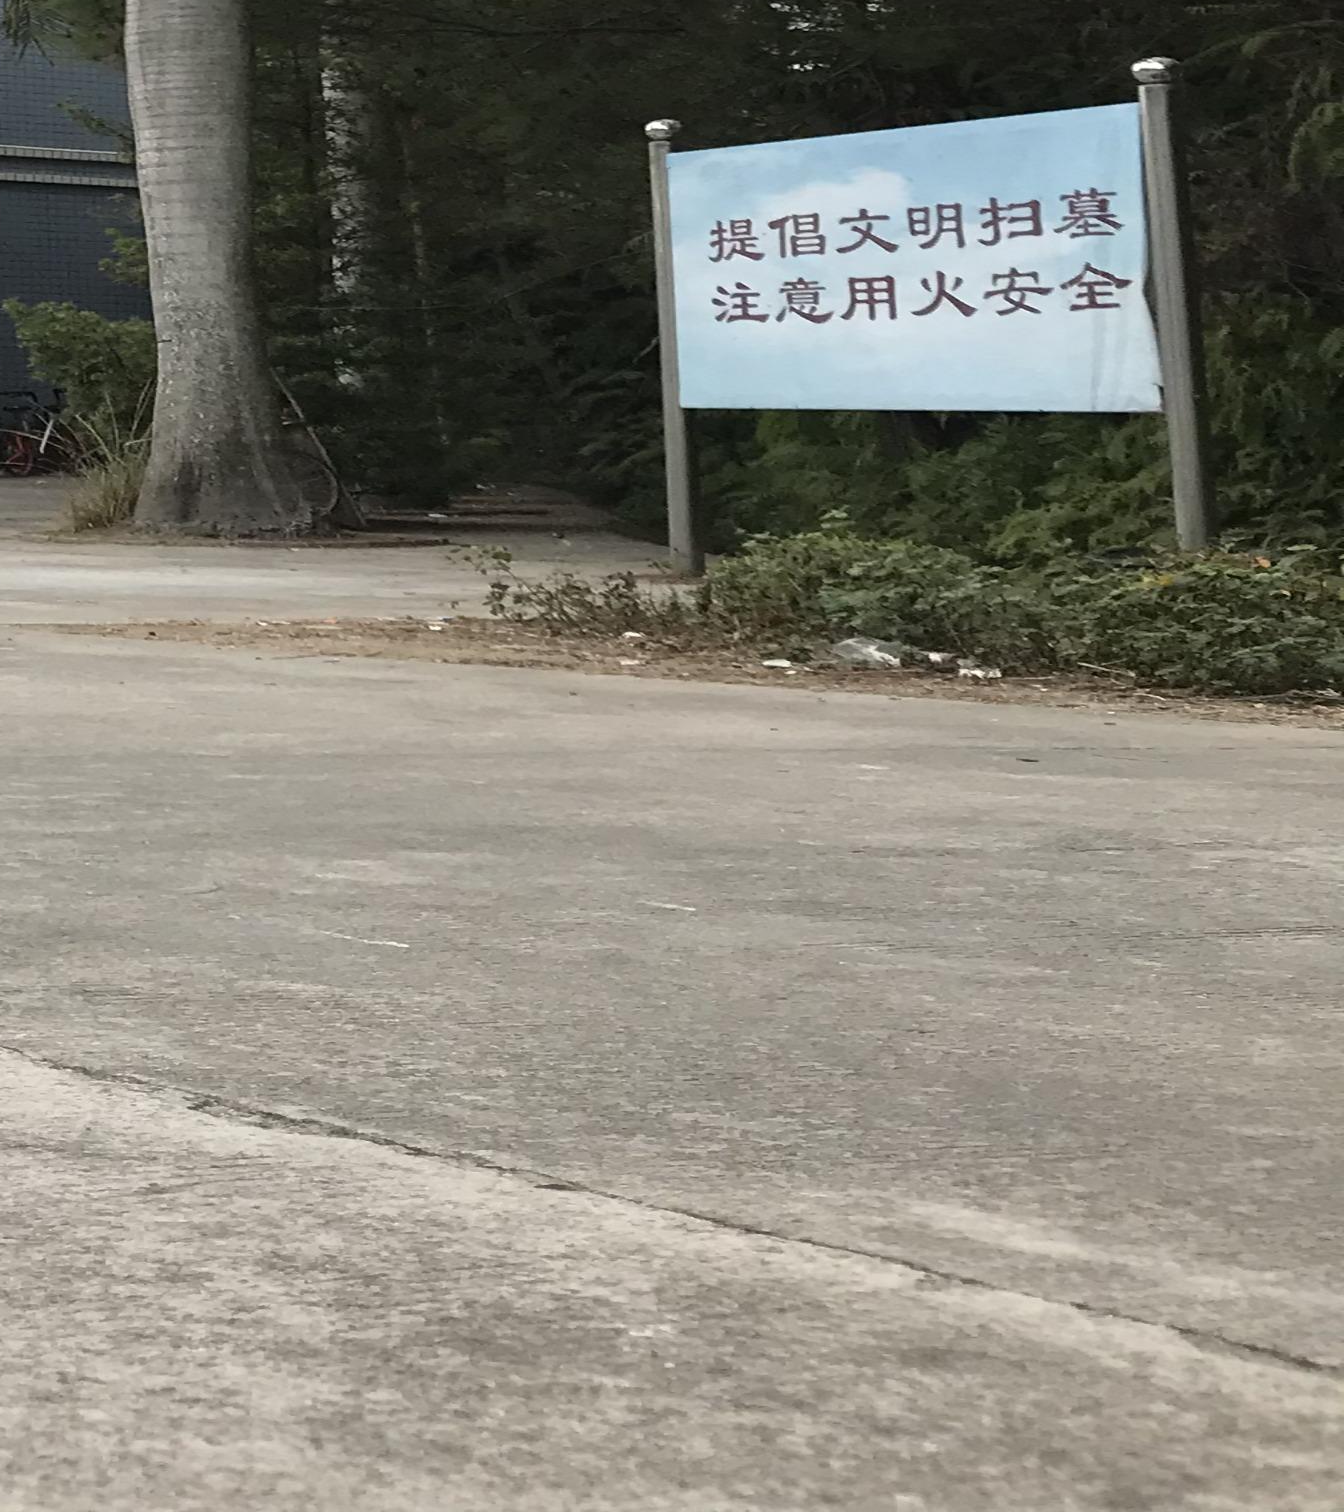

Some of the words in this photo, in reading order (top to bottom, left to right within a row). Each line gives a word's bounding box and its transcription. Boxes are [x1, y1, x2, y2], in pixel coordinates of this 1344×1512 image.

[708, 187, 1125, 263] 提倡文明扫墓
[711, 262, 1133, 324] 注意用火安全
